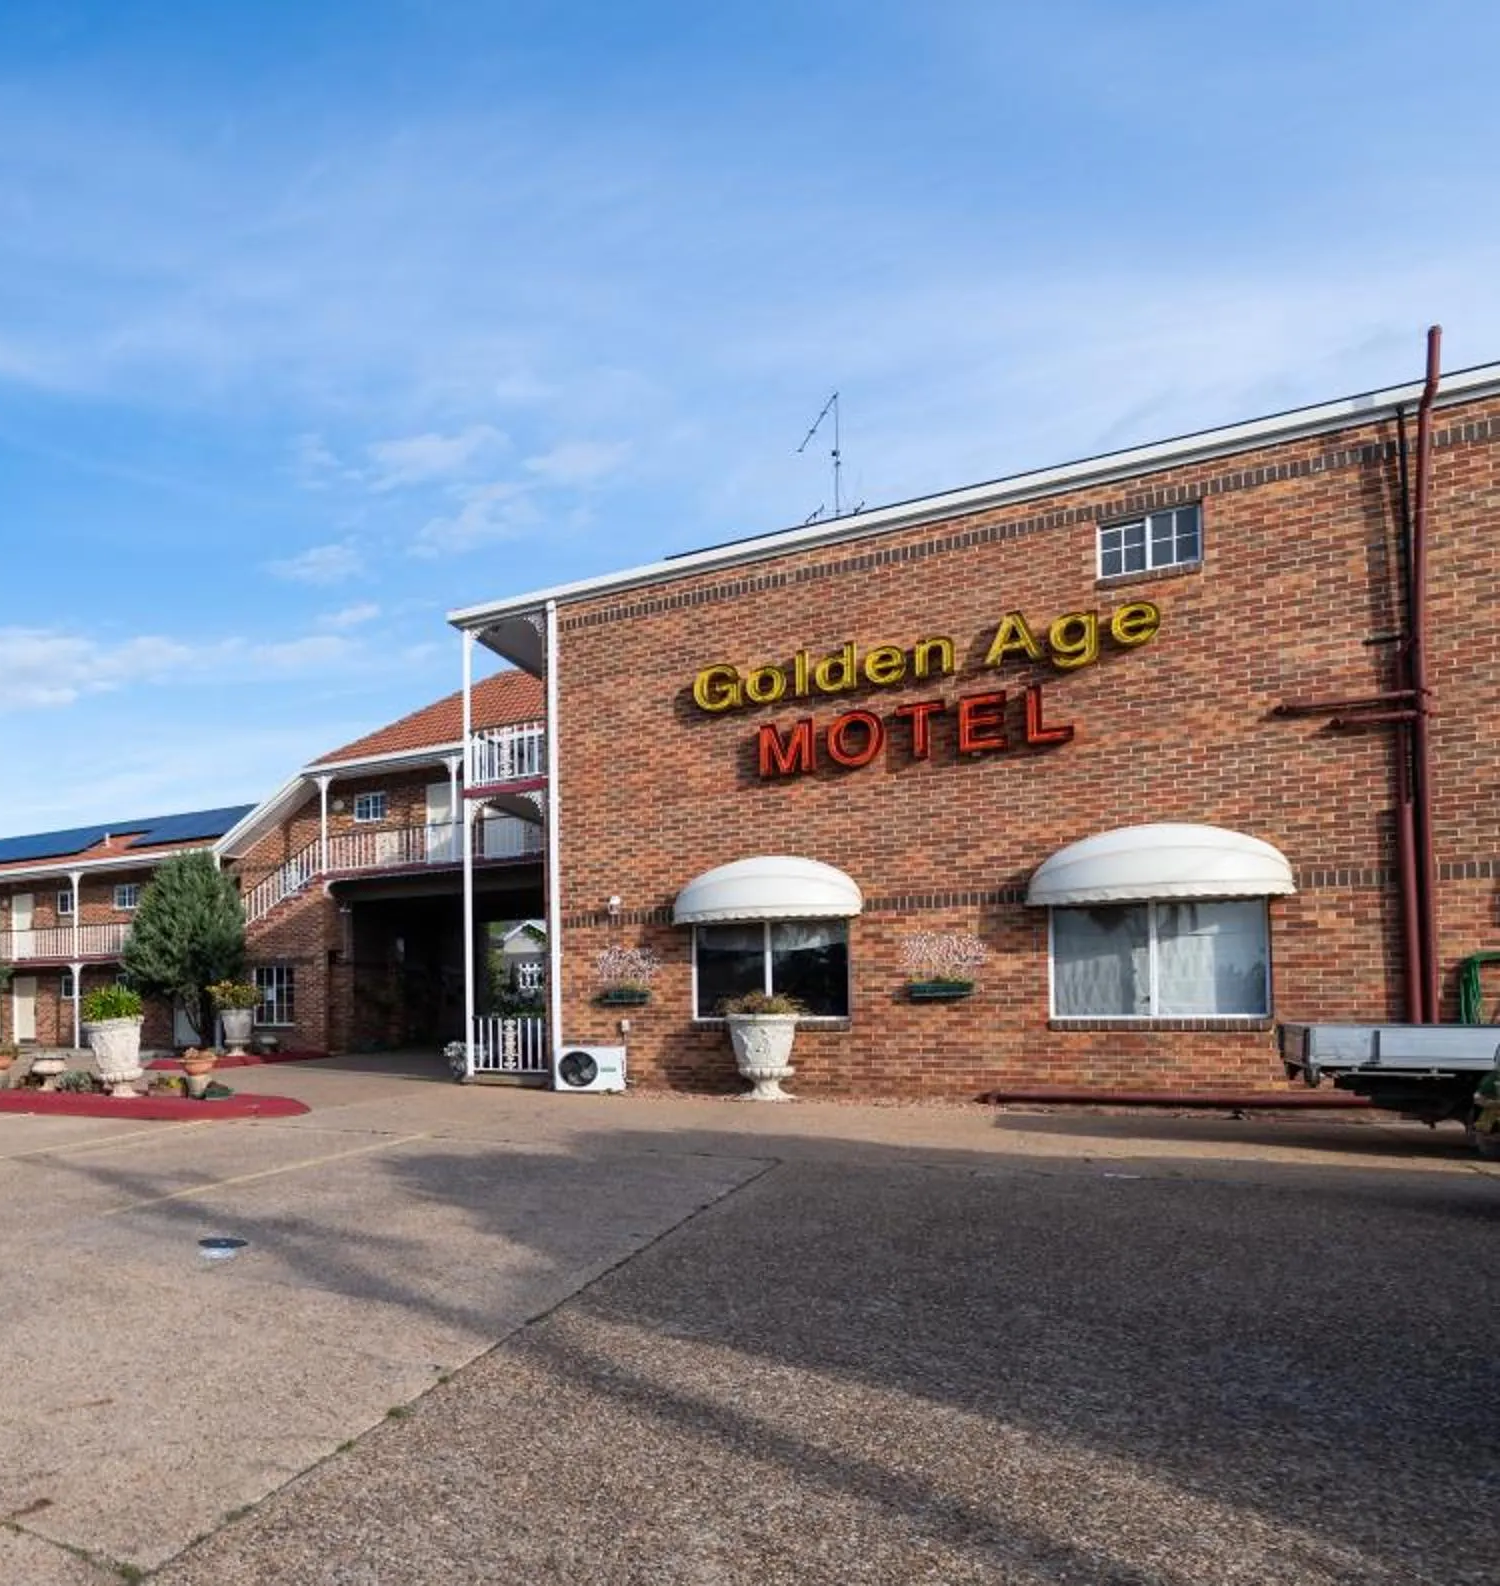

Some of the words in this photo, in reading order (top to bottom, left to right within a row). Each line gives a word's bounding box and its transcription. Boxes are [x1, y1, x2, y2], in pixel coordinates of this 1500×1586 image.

[693, 635, 955, 713] Golden
[985, 600, 1161, 669] Age
[758, 685, 1075, 780] MOTEL
